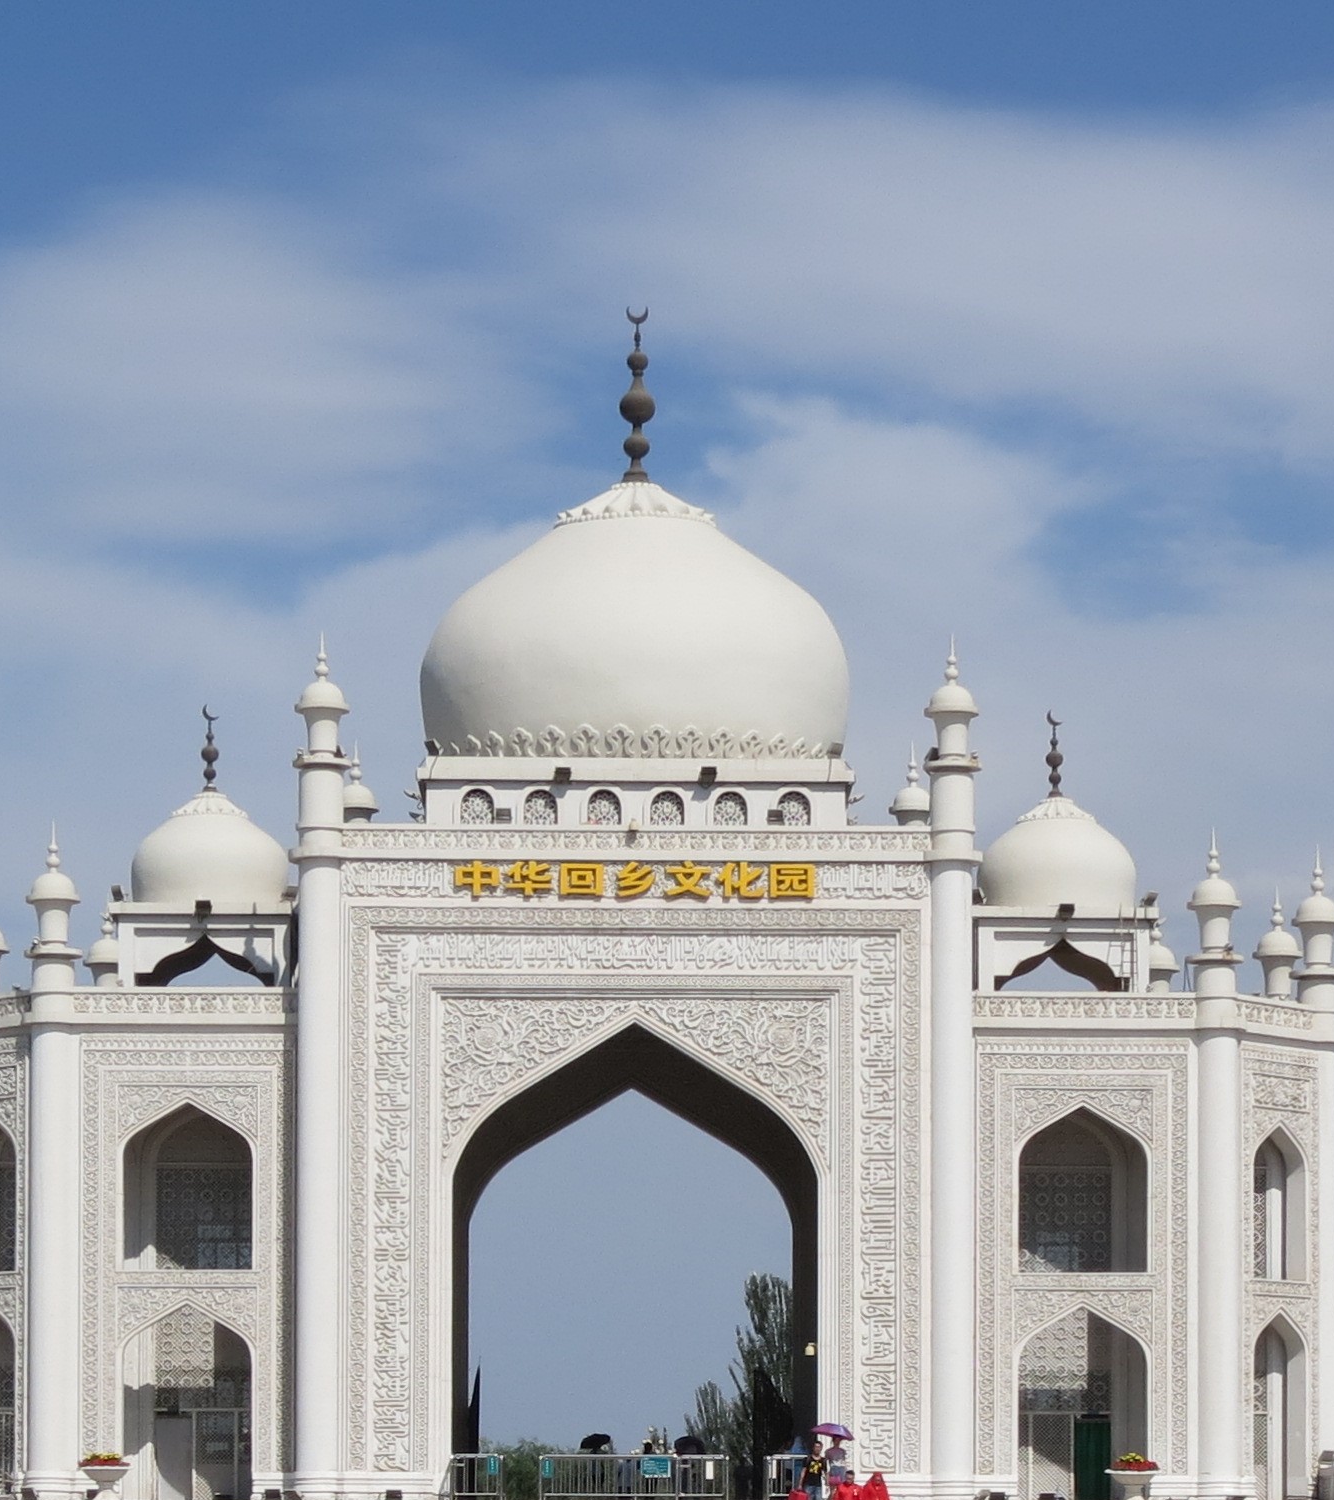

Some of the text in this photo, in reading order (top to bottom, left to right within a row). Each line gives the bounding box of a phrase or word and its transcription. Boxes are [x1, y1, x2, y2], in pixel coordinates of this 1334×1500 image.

[454, 861, 816, 897] 中华回乡文化园
